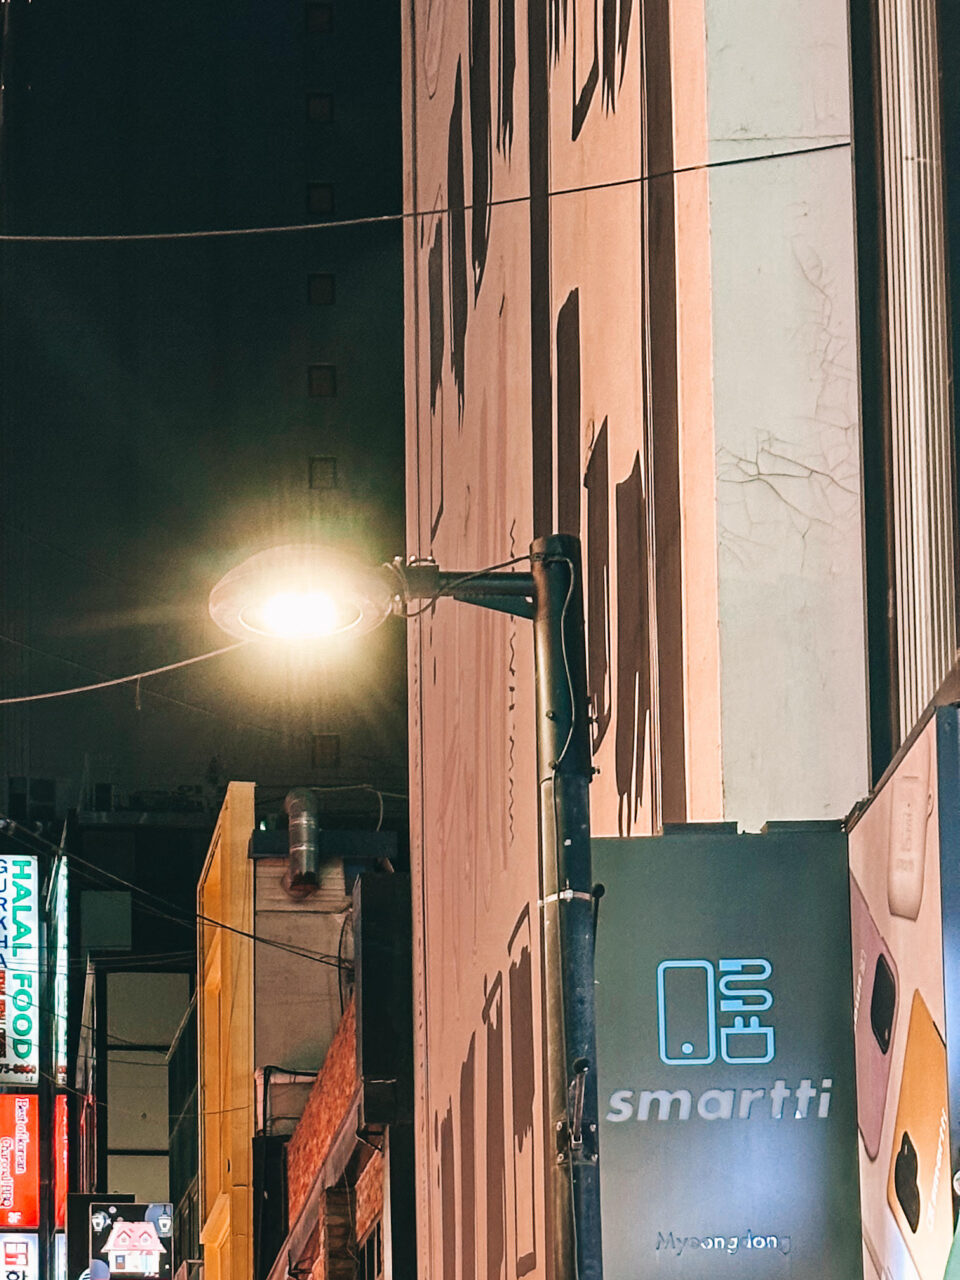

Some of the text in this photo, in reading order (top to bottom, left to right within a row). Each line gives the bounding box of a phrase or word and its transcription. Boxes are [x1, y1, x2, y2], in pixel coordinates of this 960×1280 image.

[12, 860, 32, 957] HALAL
[12, 973, 32, 1060] FOOD
[606, 1078, 833, 1123] smartti
